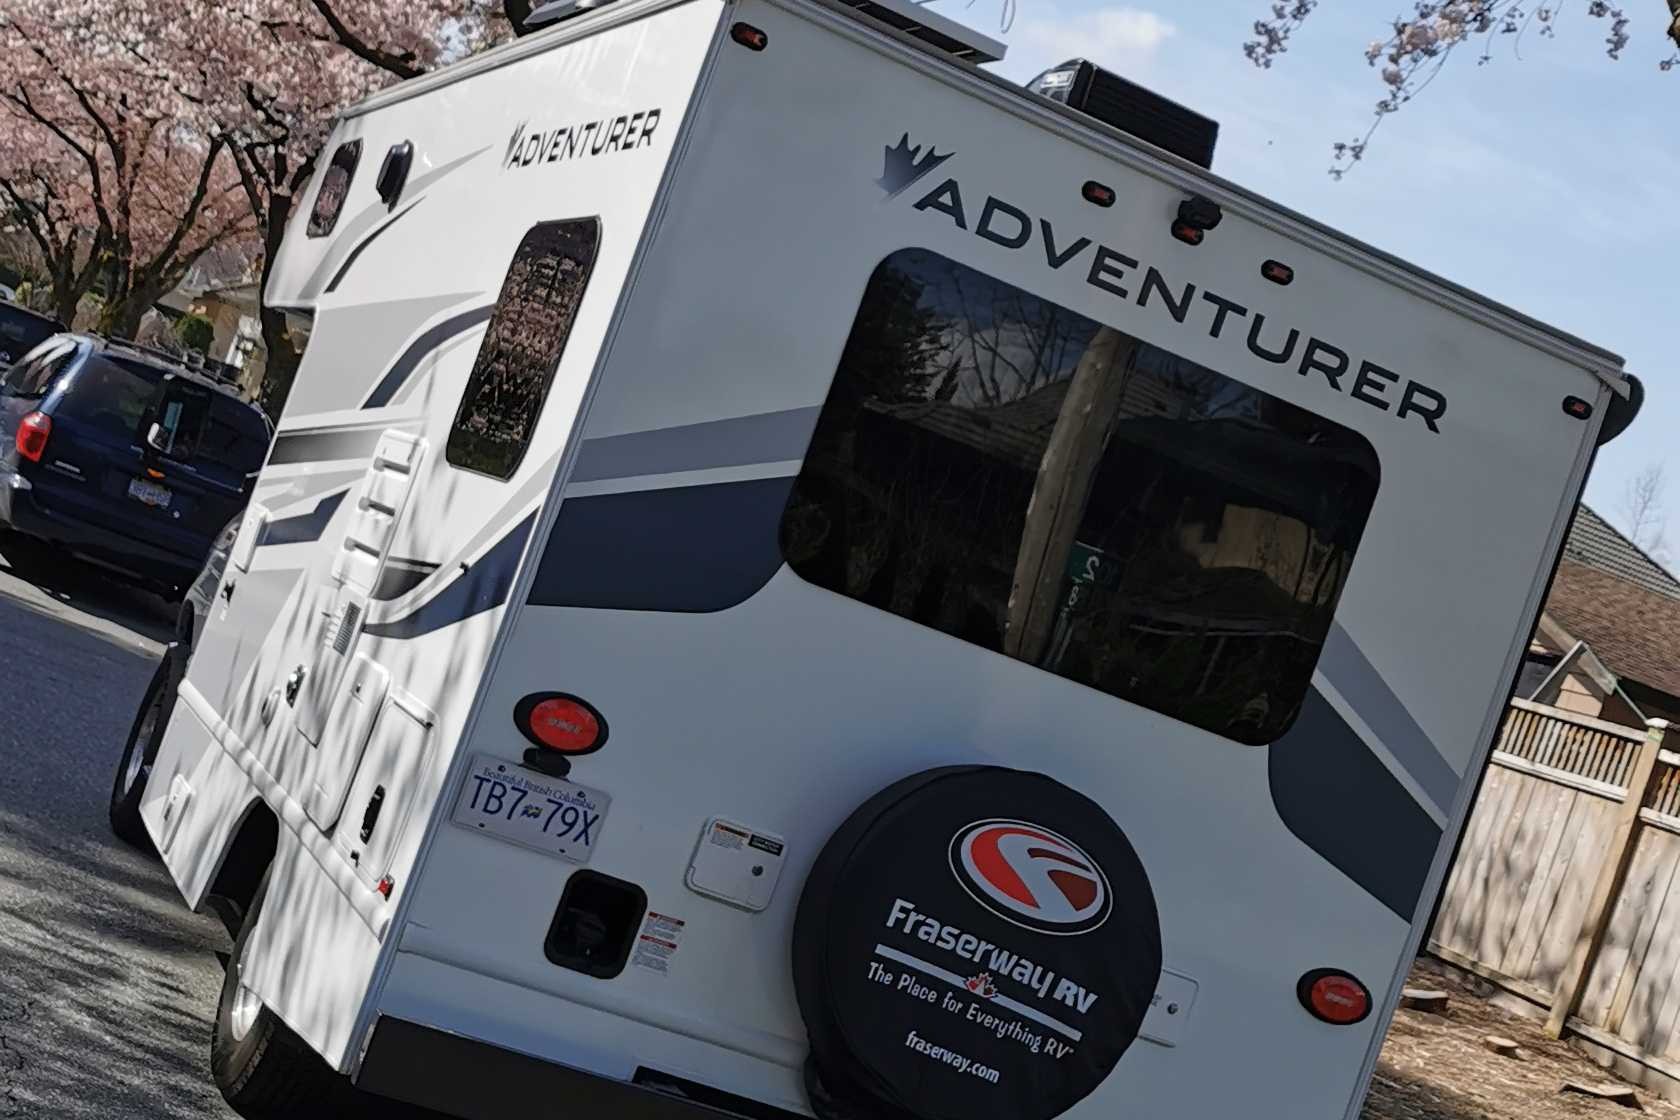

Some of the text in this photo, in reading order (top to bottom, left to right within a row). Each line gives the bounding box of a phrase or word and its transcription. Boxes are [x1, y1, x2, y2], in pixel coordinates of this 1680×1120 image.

[506, 108, 661, 170] ADVENTURER
[912, 177, 1448, 434] ADVENTURER
[886, 897, 1099, 1015] Fraserway RV
[867, 961, 894, 985] The
[897, 973, 937, 1003] Place
[943, 991, 964, 1014] for
[966, 1003, 1042, 1054] Everything
[904, 1030, 1000, 1084] fraserway.com
